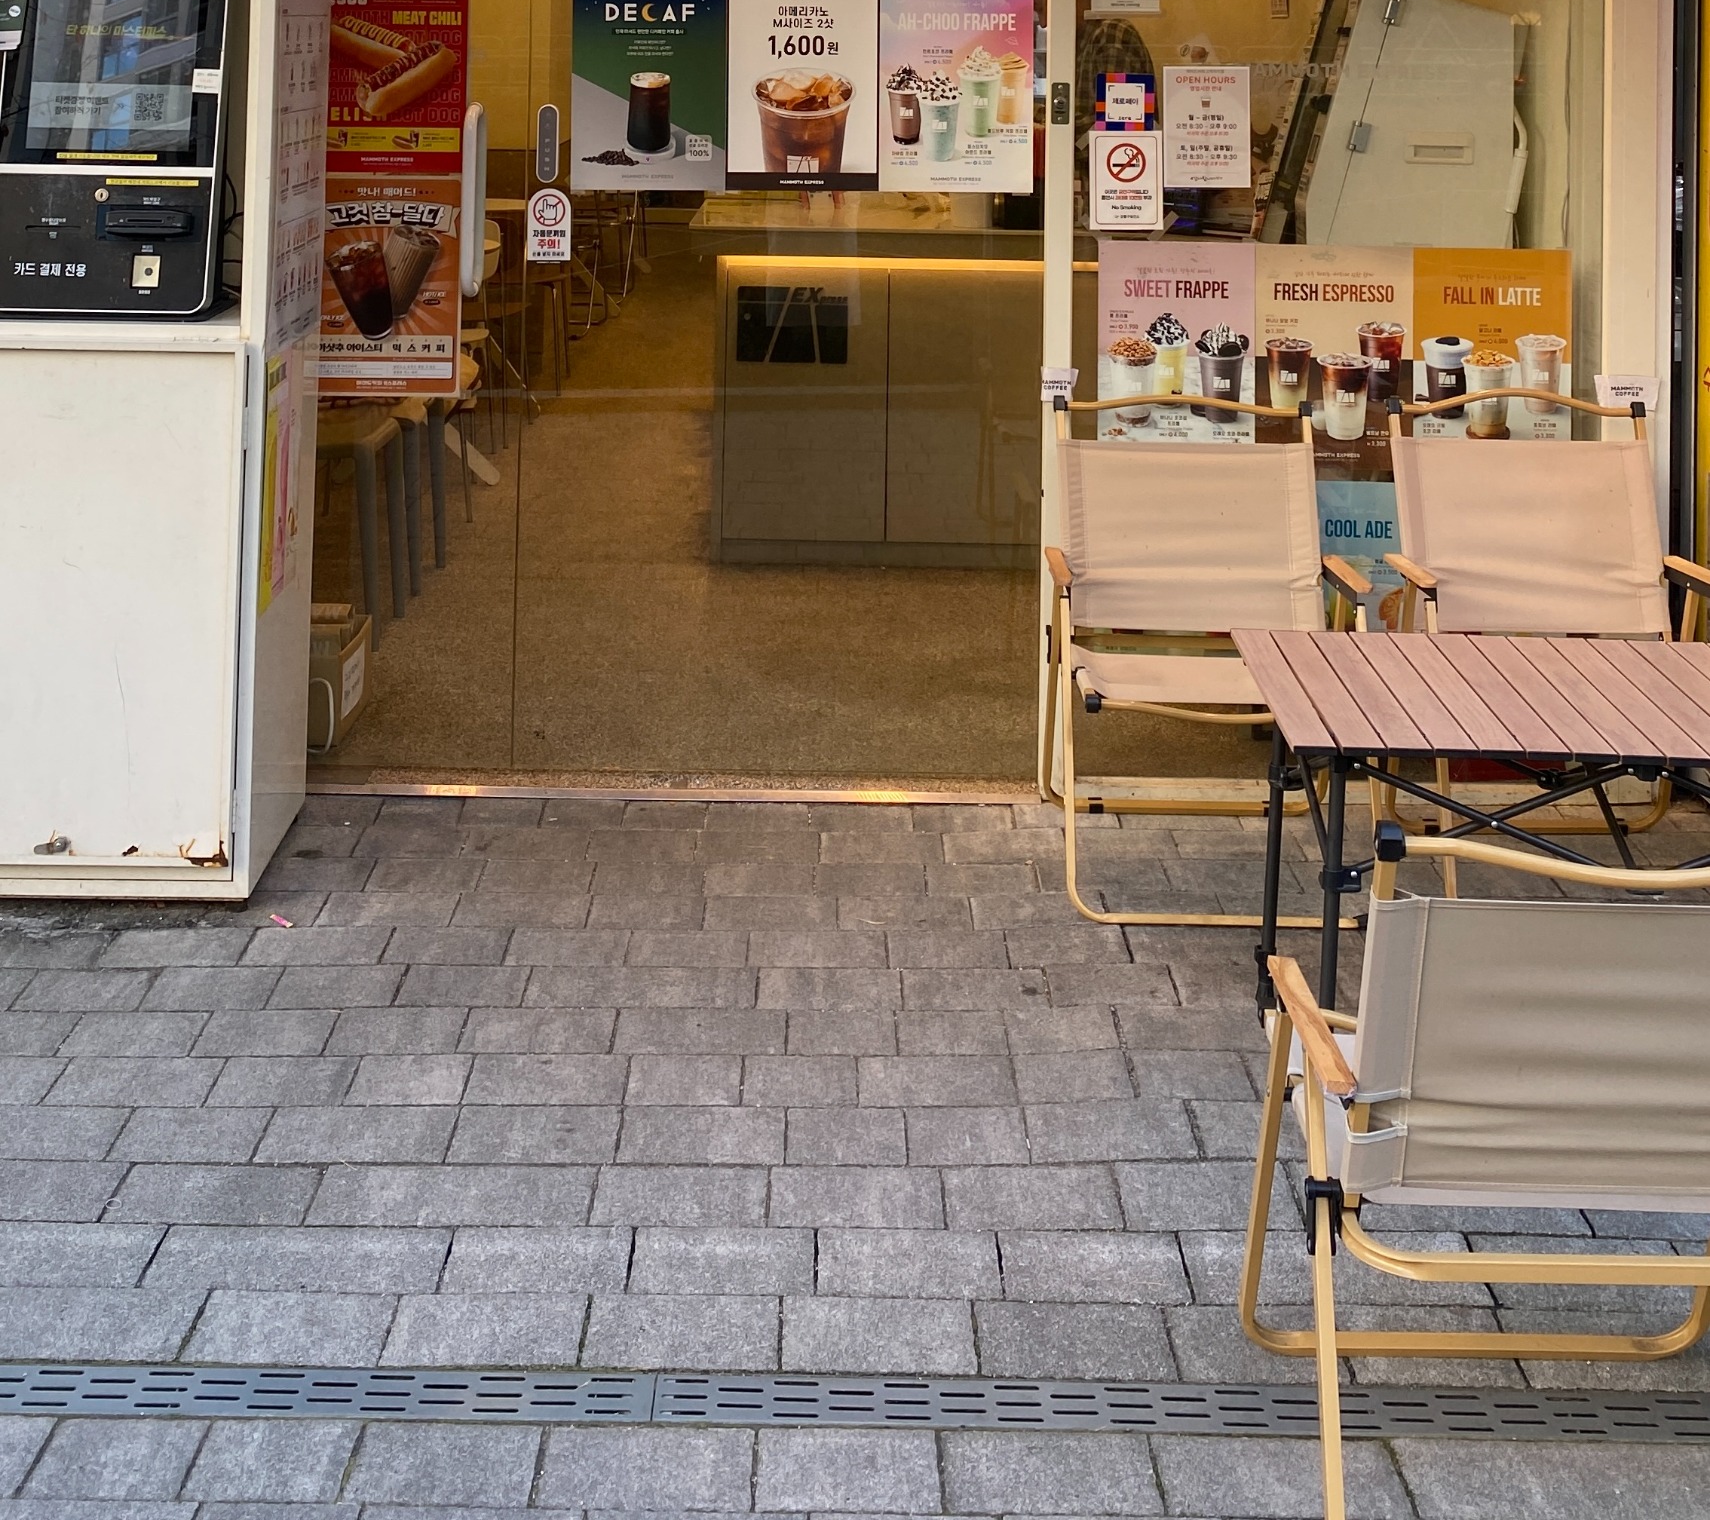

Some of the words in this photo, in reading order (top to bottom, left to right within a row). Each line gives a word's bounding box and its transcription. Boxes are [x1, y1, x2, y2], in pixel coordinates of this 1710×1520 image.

[392, 10, 427, 25] MEAT
[429, 11, 462, 26] CHILI
[605, 3, 695, 22] DECAF
[778, 6, 829, 16] 아메리카노
[773, 18, 813, 29] M사이즈
[817, 18, 834, 29] 2샷
[898, 13, 960, 31] AH-CHOO
[964, 13, 1017, 31] FRAPPE
[1176, 76, 1201, 84] OPEN
[1204, 76, 1236, 84] HOURS
[1112, 98, 1139, 106] 제로페이
[689, 149, 710, 157] 100%
[357, 187, 380, 197] 맛나!
[326, 201, 369, 224] 고것
[537, 238, 561, 249] 주의!
[13, 262, 37, 276] 카드
[39, 263, 62, 277] 결제
[65, 264, 87, 278] 전용
[1124, 279, 1172, 299] SWEET
[1175, 280, 1229, 299] FRAPPE
[1274, 283, 1319, 301] FRESH
[1322, 284, 1394, 303] ESPRESSO
[1443, 286, 1477, 305] FALL
[1480, 287, 1495, 305] IN
[1498, 287, 1542, 307] LATTE
[346, 343, 383, 353] 아이스티
[1325, 519, 1361, 539] COOL
[1365, 521, 1393, 540] ADE
